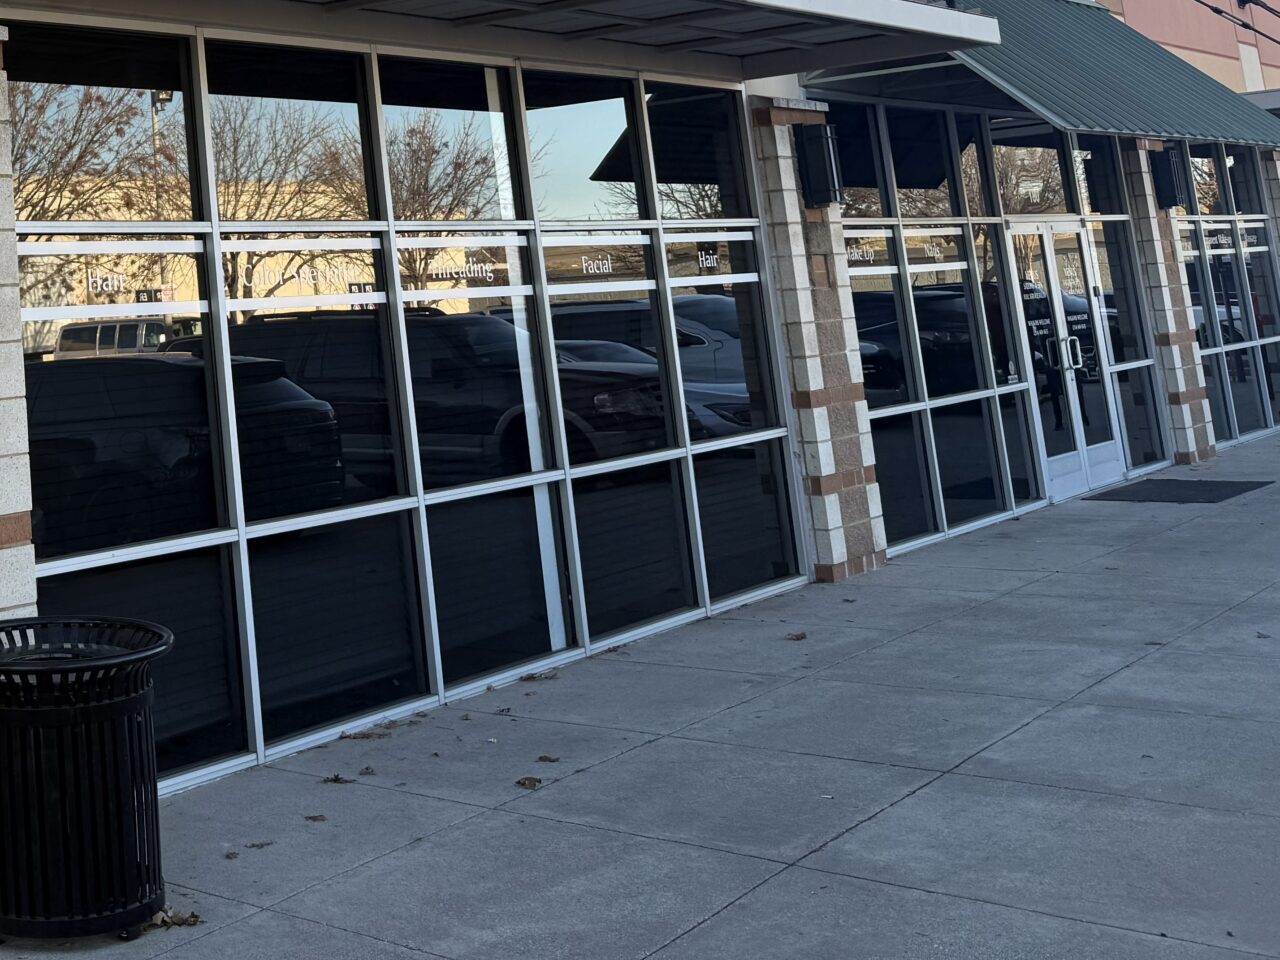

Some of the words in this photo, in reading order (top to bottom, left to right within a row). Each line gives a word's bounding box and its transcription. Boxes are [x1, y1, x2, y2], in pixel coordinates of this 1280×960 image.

[698, 250, 718, 269] Hair
[863, 244, 874, 264] Up
[924, 242, 940, 258] Nails
[243, 263, 284, 287] Color
[429, 255, 495, 281] Threading
[581, 254, 613, 275] Facial
[87, 268, 125, 291] Hair
